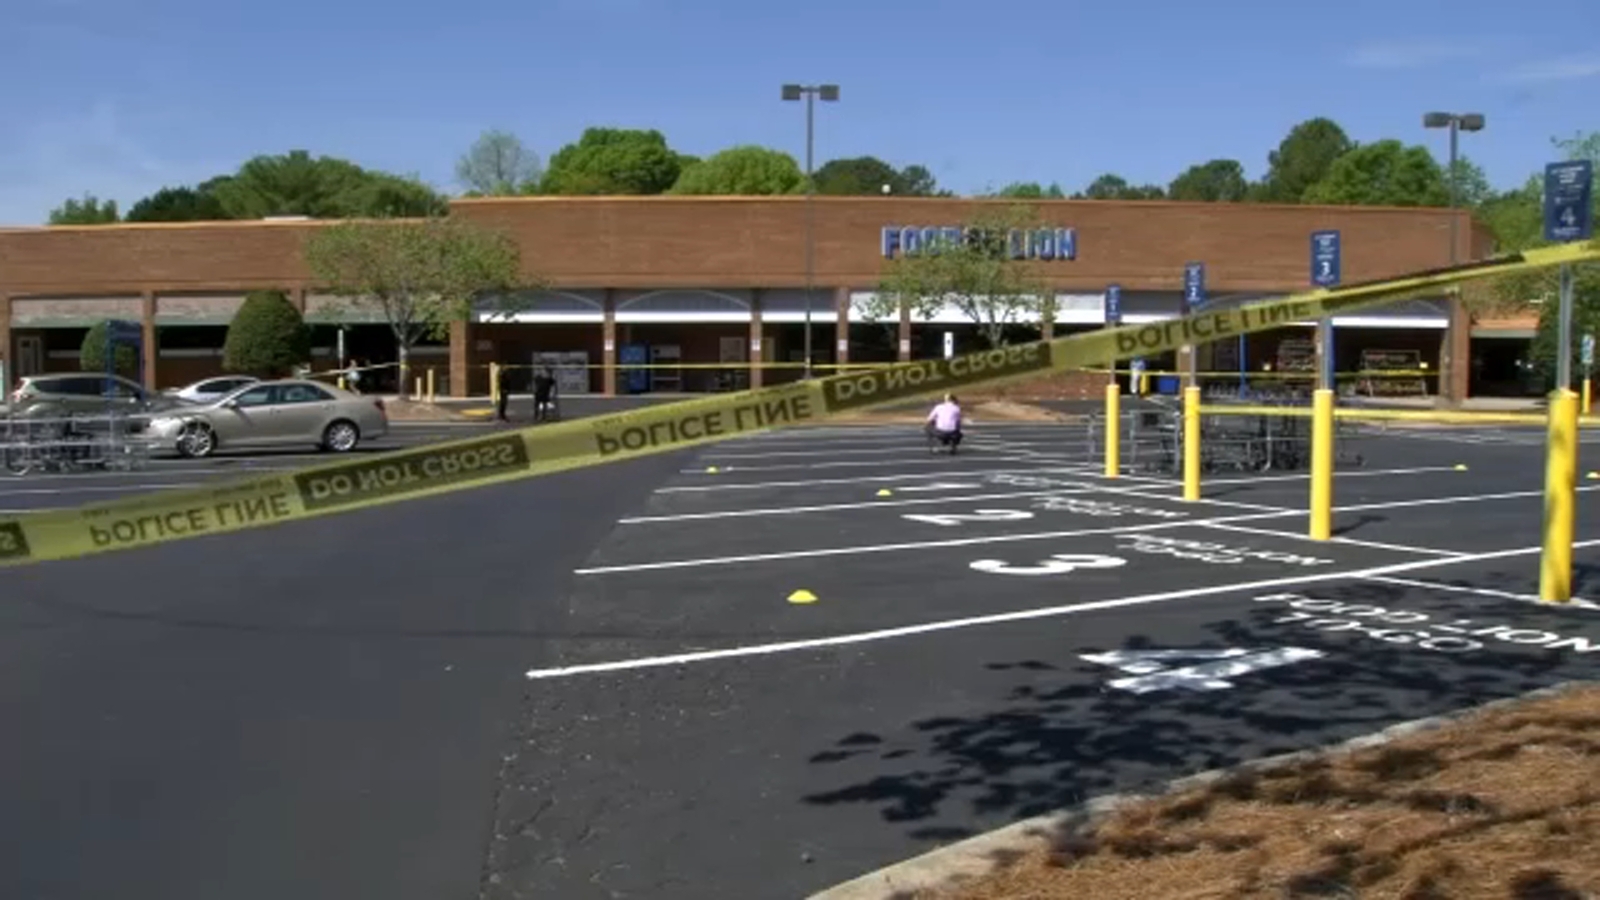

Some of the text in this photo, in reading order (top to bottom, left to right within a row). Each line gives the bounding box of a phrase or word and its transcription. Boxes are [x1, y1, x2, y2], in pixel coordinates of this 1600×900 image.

[1006, 226, 1079, 261] LION
[1320, 261, 1331, 277] 3
[902, 509, 1034, 526] 2
[969, 553, 1127, 575] 3
[1078, 646, 1328, 694] 4
